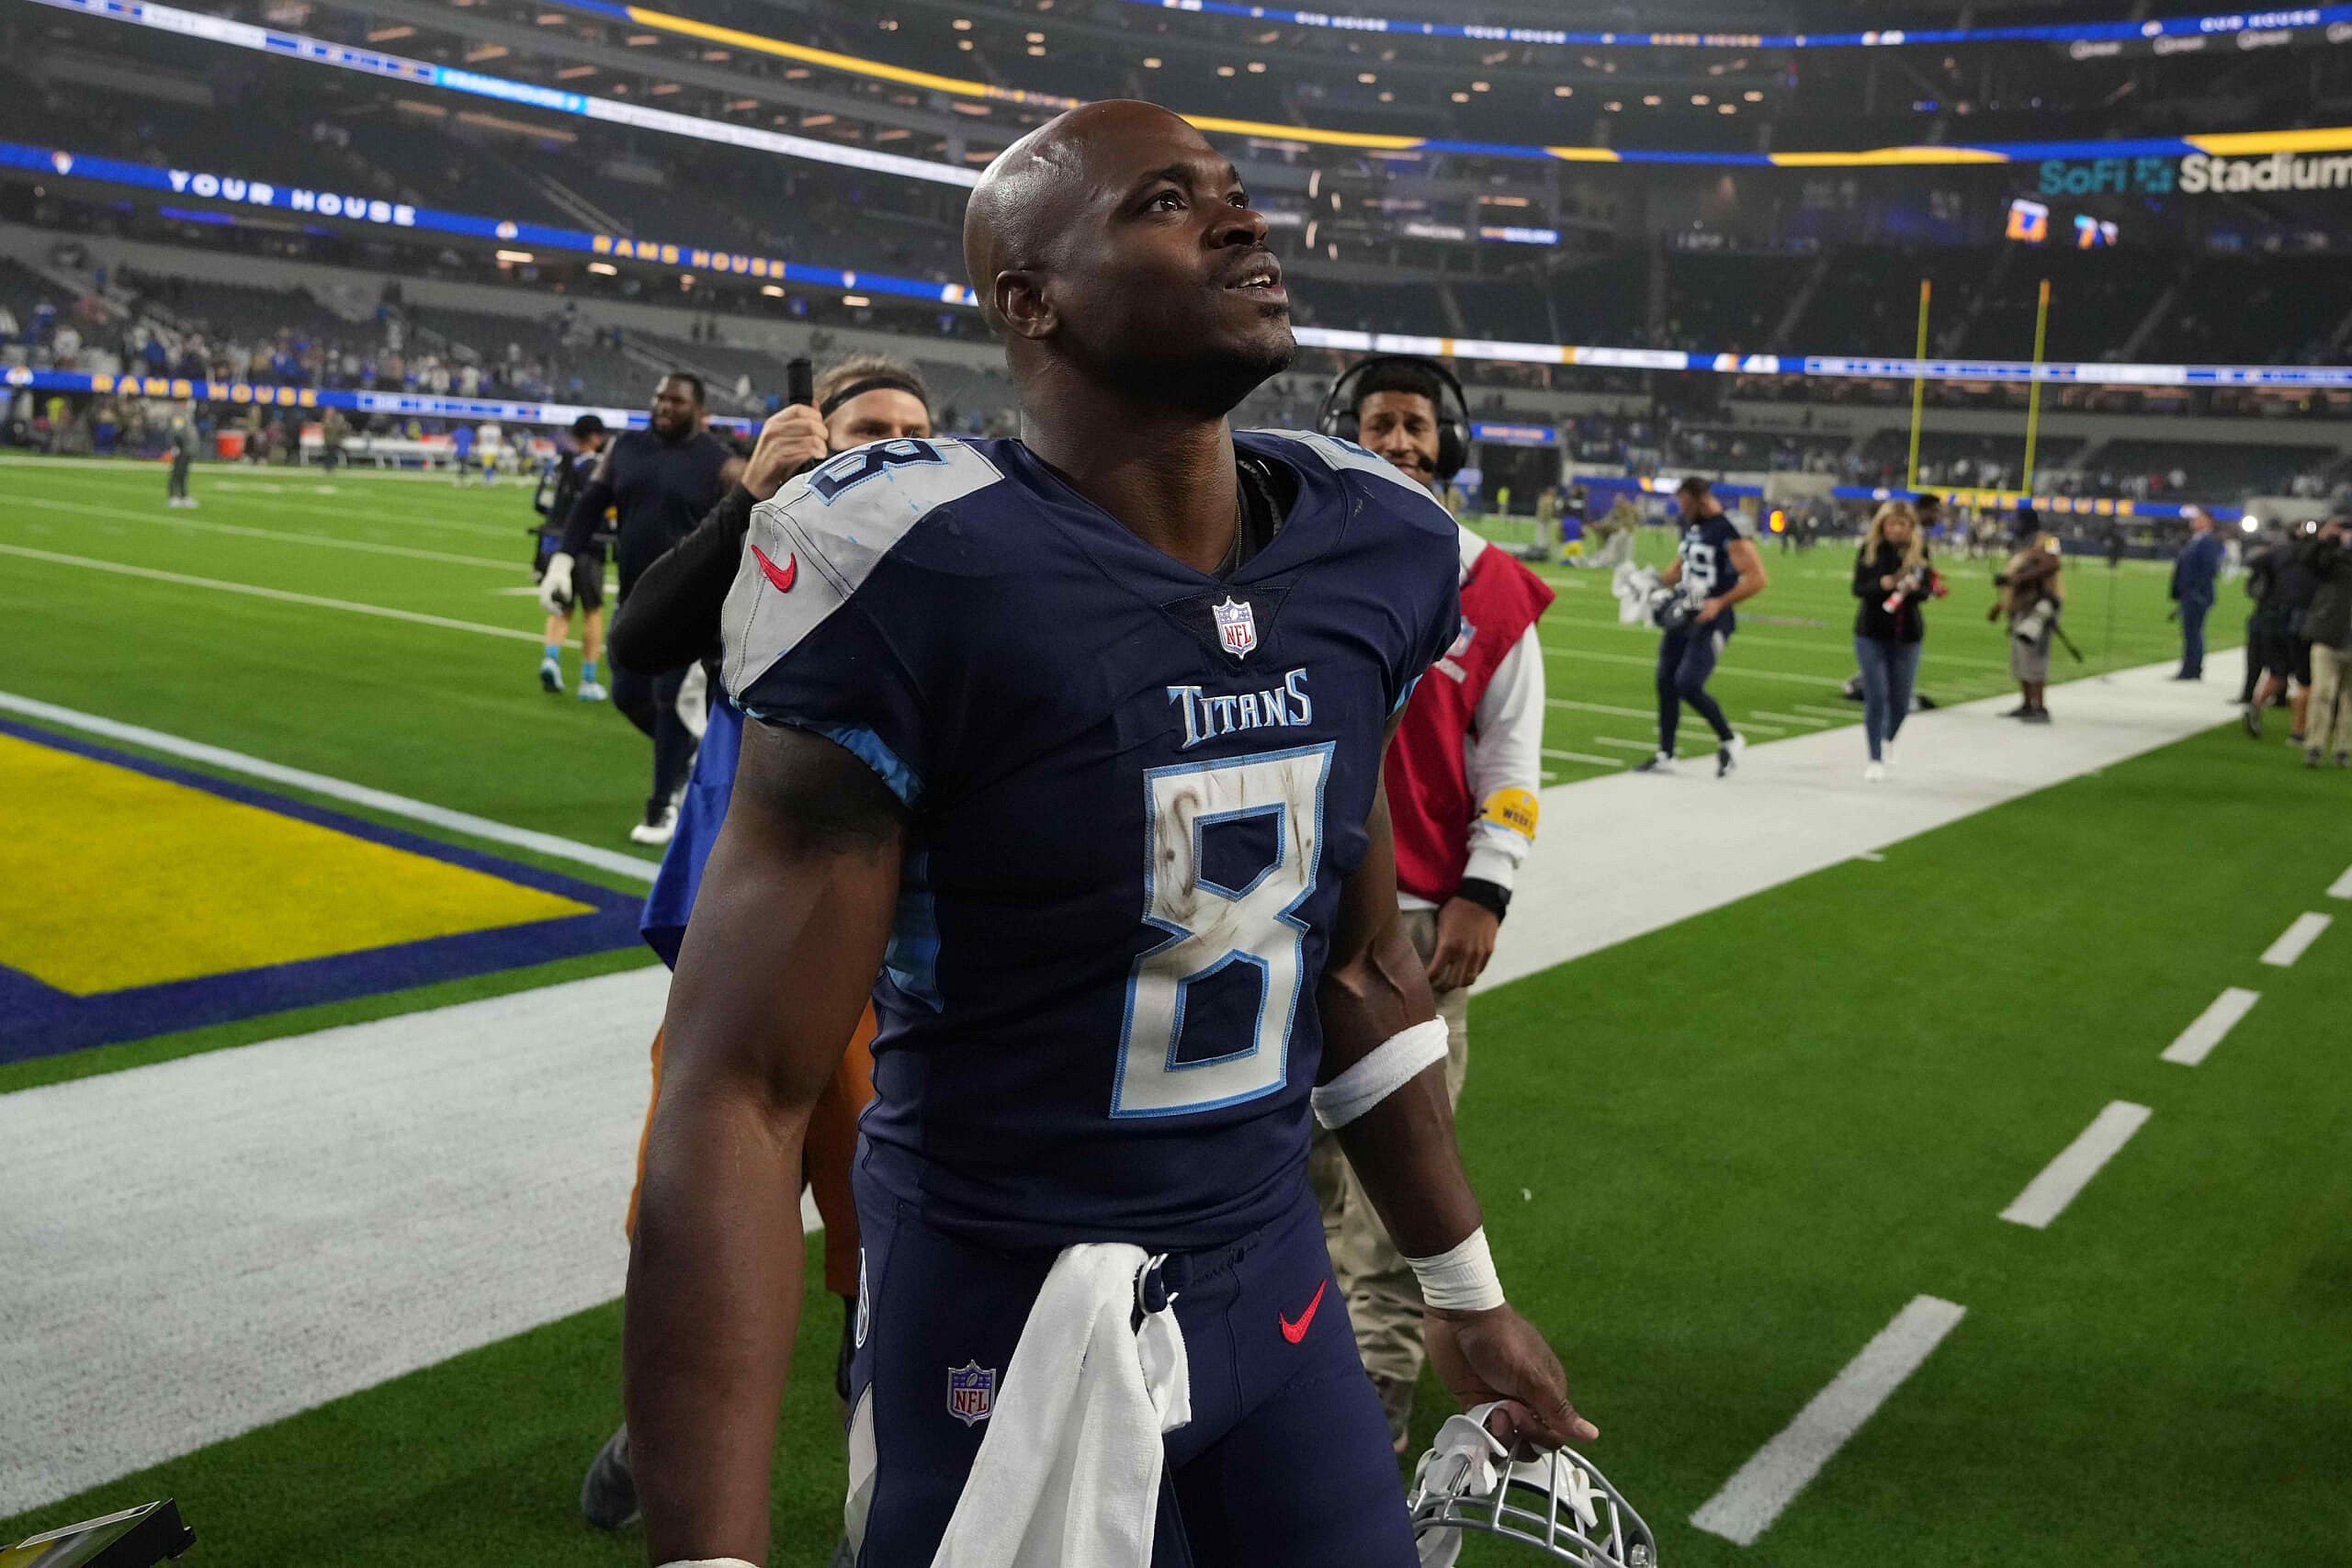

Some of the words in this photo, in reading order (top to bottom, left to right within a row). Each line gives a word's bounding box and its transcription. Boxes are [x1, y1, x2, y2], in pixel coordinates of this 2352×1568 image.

[2039, 158, 2127, 195] SoFi
[2179, 152, 2352, 193] Stadium
[168, 169, 275, 206] YOUR
[290, 188, 415, 227] HOUSE
[592, 234, 680, 265] RAMS
[691, 249, 786, 279] HOUSE
[91, 374, 193, 399] RAMS
[207, 382, 318, 408] HOUSE
[1224, 623, 1252, 648] NFL
[1166, 668, 1313, 750] TITANS
[1109, 740, 1337, 1120] 8
[955, 1389, 988, 1415] NFL
